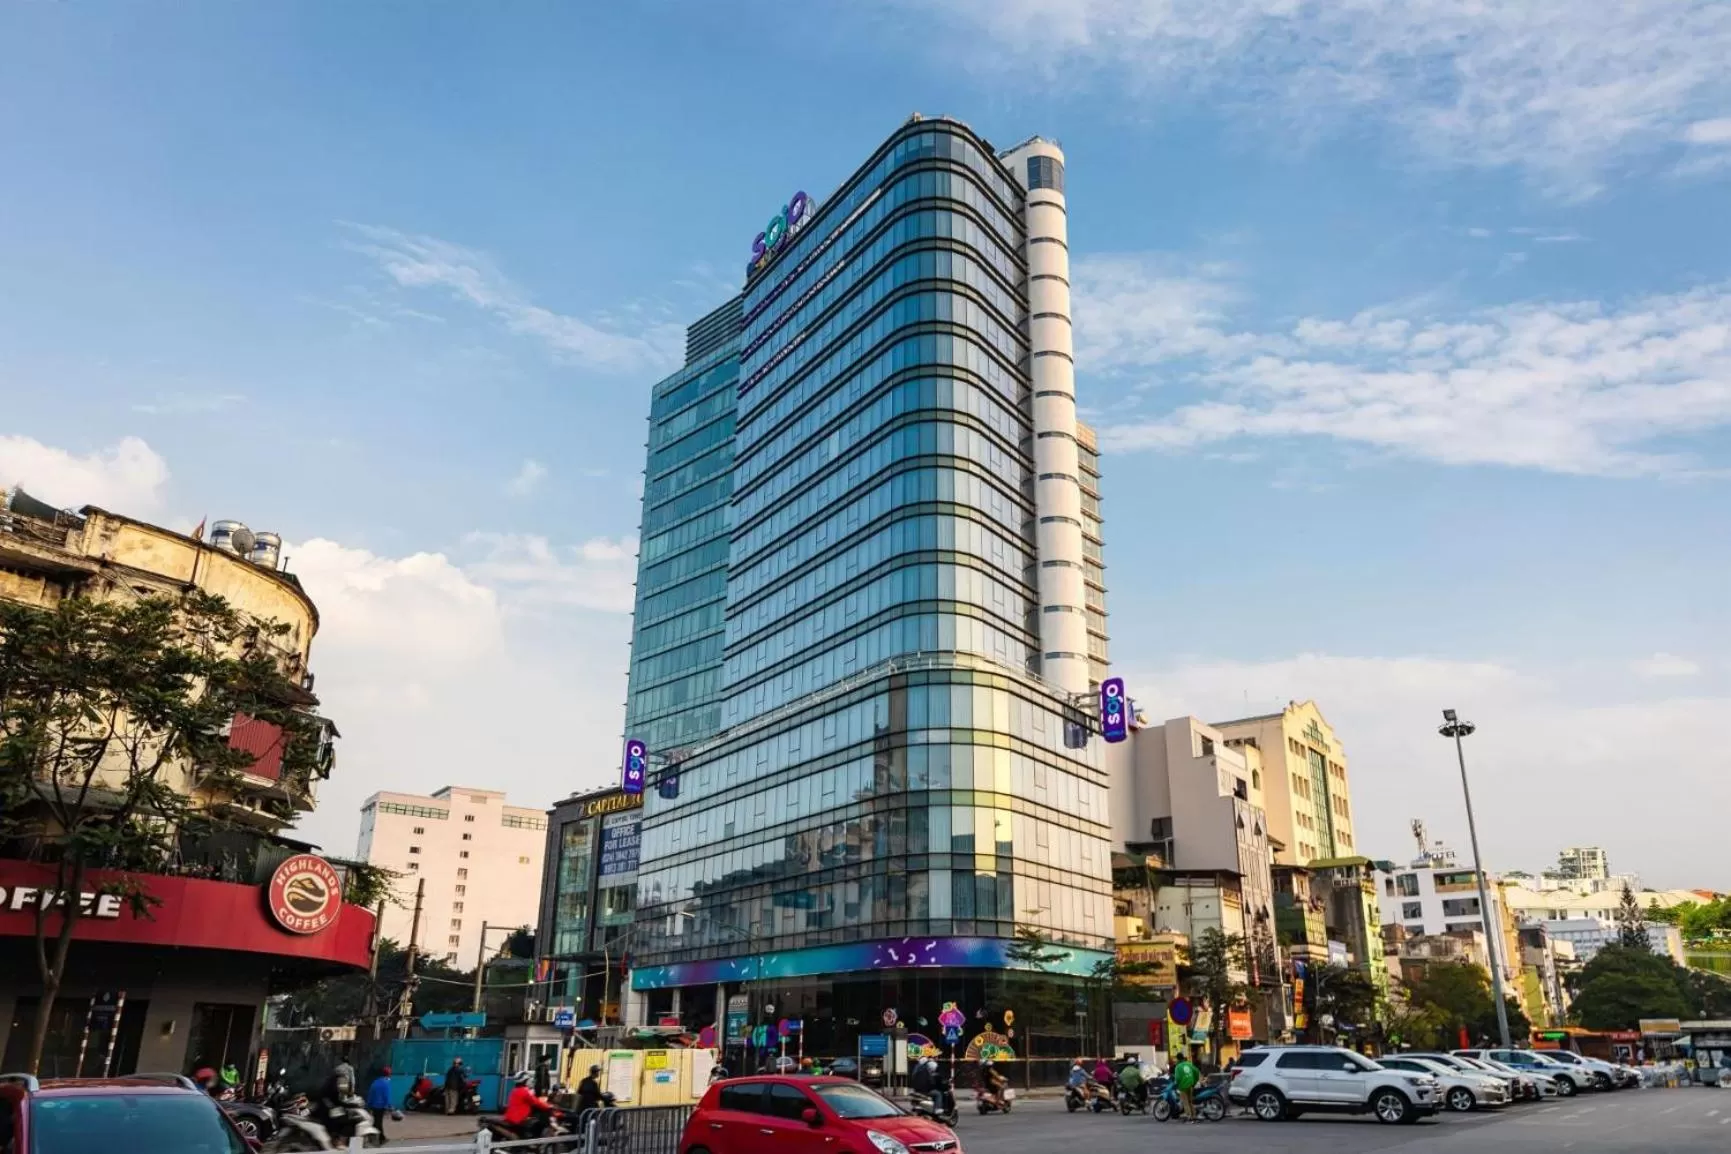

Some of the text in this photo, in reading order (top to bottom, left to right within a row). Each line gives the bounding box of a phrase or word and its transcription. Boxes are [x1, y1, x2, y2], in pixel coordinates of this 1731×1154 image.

[588, 794, 626, 815] CAPITAL
[611, 825, 635, 838] OFFICE
[604, 835, 641, 851] FOR LEASE
[276, 859, 339, 897] HIGHLANDS
[279, 907, 328, 930] COFFEE
